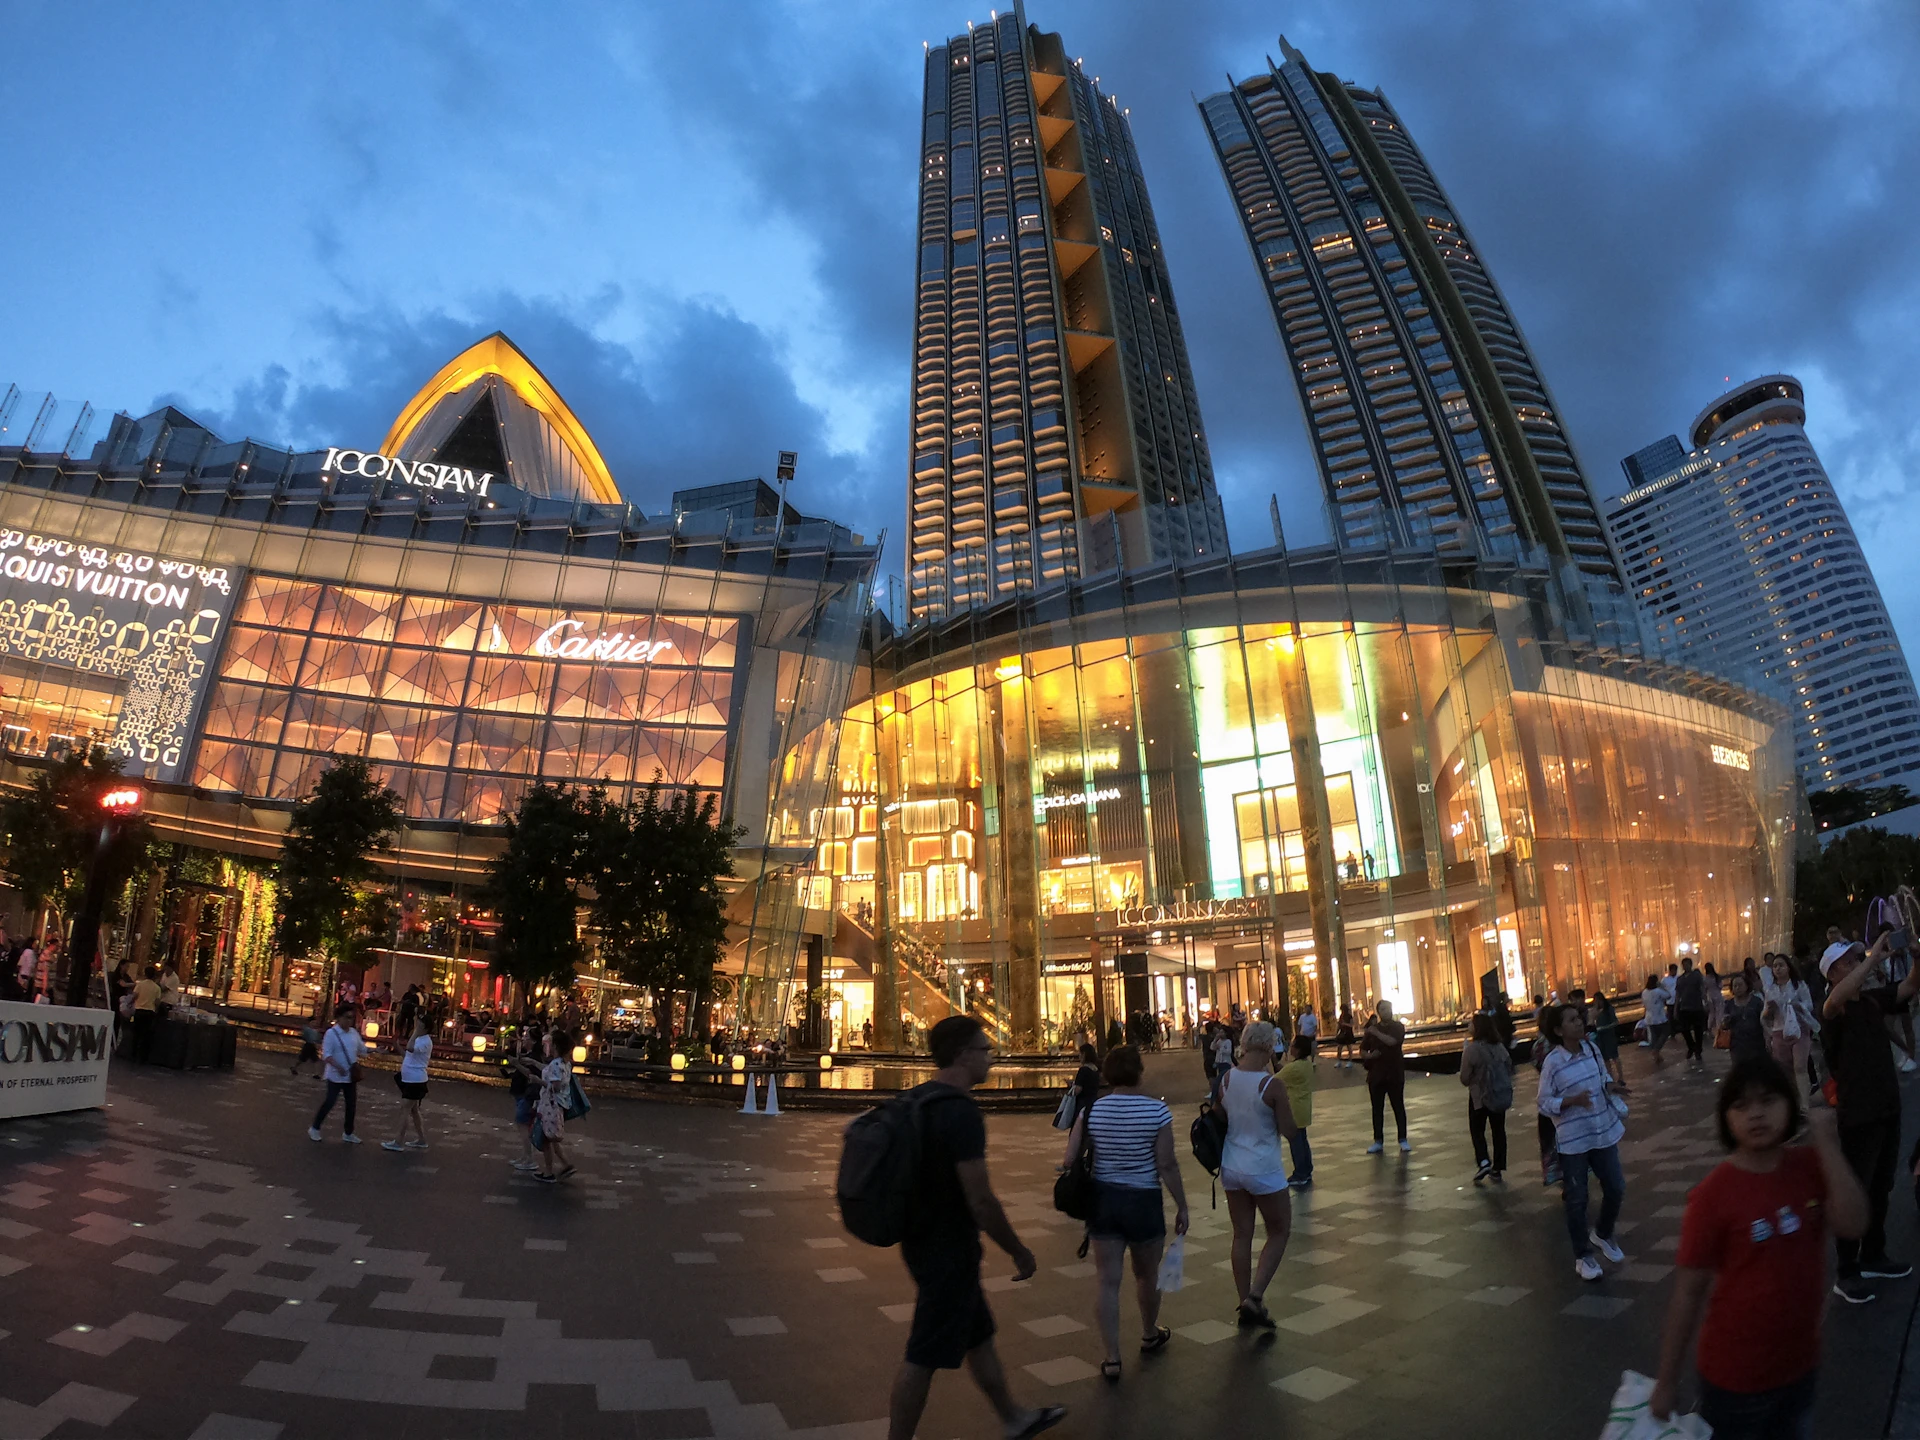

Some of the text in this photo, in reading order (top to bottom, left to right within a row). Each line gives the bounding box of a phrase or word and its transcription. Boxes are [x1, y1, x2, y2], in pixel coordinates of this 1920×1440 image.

[321, 447, 494, 497] ICONSIAM
[1620, 457, 1712, 506] Millennium Hilton
[76, 568, 190, 610] VUITTON
[535, 619, 672, 662] Cartier
[0, 1020, 108, 1063] ONSIAM
[7, 1079, 18, 1088] OF
[21, 1078, 54, 1088] ETERNAL
[57, 1075, 98, 1085] PROSPERITY
